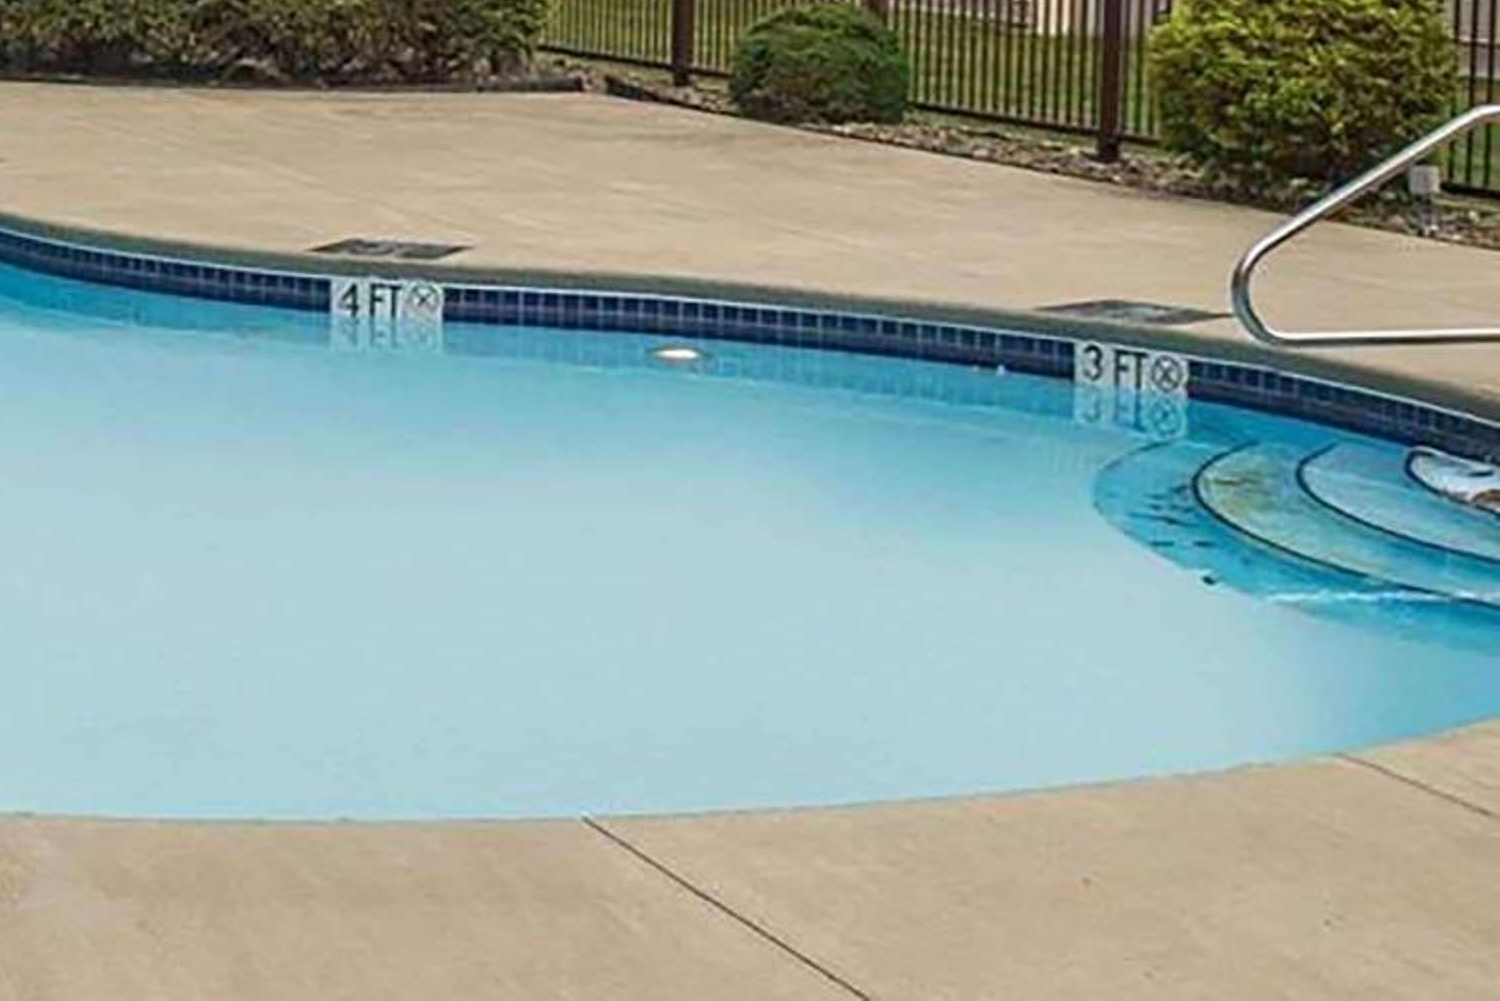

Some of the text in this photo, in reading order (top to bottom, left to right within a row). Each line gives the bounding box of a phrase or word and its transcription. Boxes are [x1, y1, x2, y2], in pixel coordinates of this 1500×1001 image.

[340, 283, 403, 319] 4 FT
[1082, 344, 1149, 388] 3 FT
